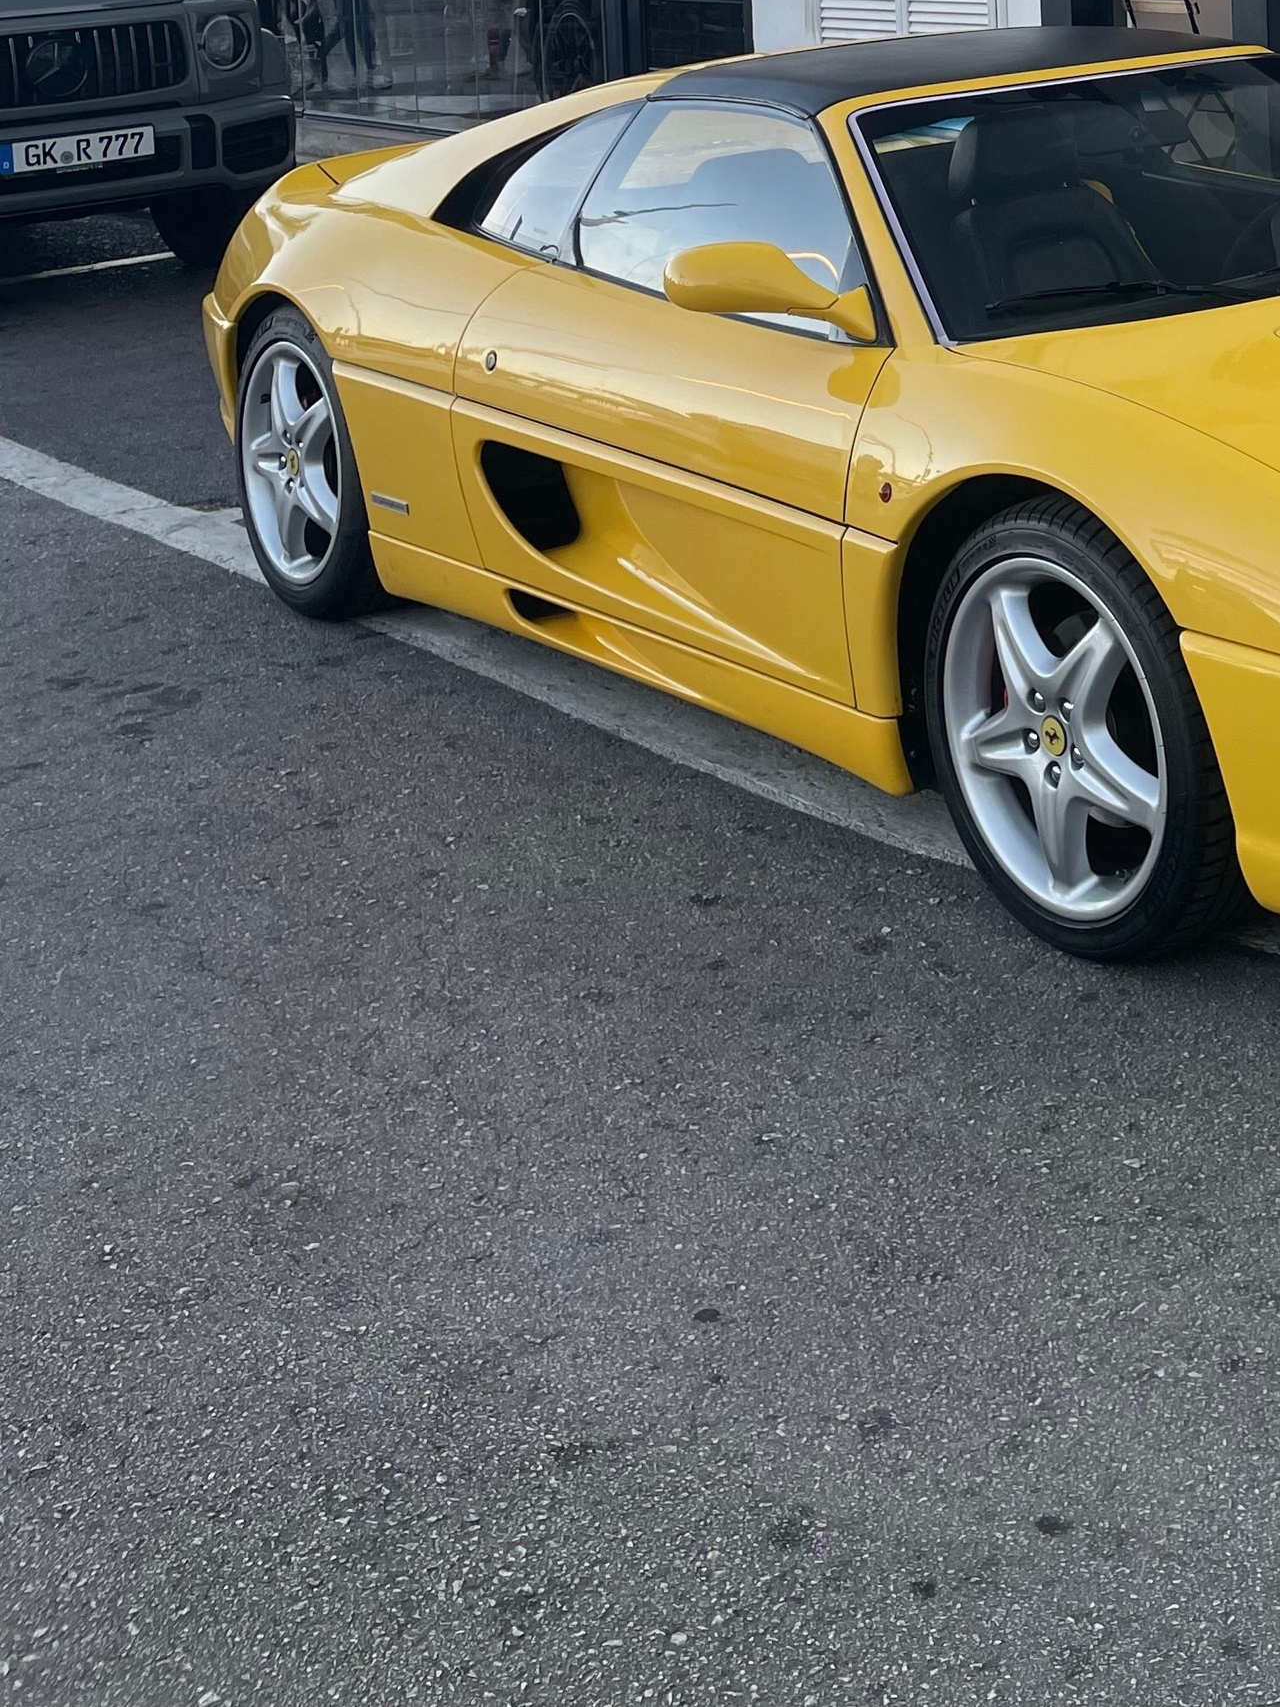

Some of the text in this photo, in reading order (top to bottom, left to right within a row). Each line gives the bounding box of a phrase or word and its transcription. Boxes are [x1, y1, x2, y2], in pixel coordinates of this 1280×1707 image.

[25, 132, 144, 166] GK R 777
